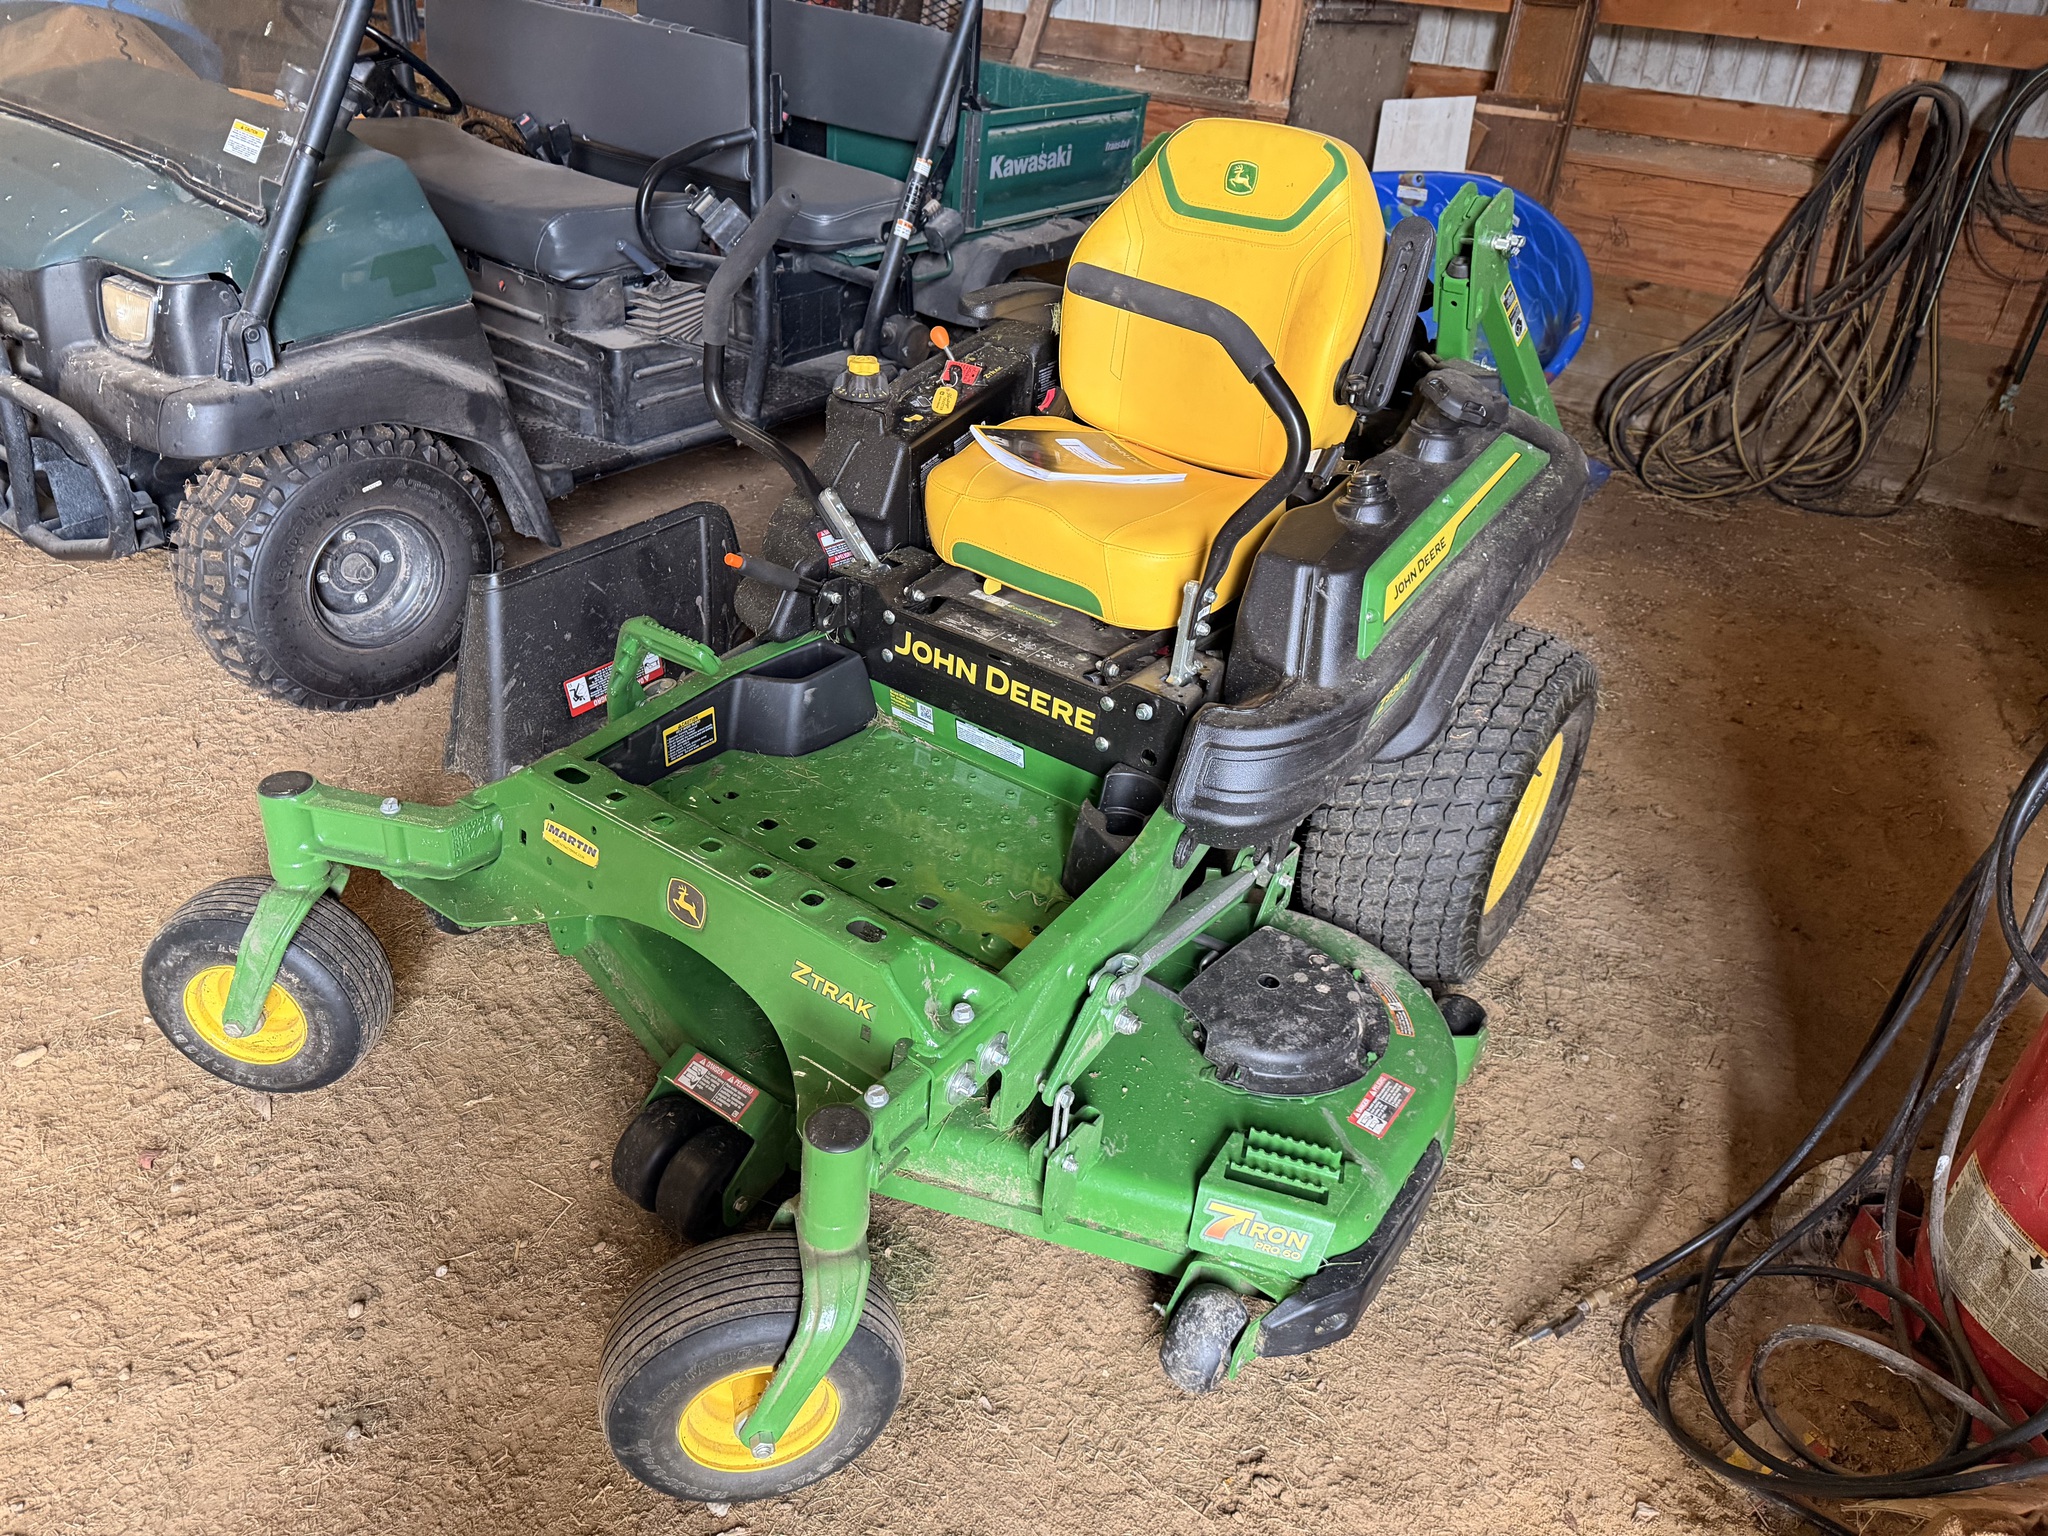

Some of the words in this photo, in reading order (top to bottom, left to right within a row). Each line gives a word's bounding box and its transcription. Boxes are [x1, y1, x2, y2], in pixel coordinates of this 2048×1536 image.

[989, 143, 1073, 180] Kawasaki
[1394, 567, 1418, 600] JOHN
[1417, 536, 1447, 574] DEERE
[894, 630, 977, 685] JOHN
[985, 664, 1096, 735] DEERE
[548, 824, 598, 858] MARTIN
[790, 959, 876, 1022] ZTRAK
[705, 1060, 725, 1077] DANGER
[733, 1078, 755, 1095] PELIGRO
[1253, 1241, 1281, 1255] PRO
[1282, 1249, 1302, 1261] 60
